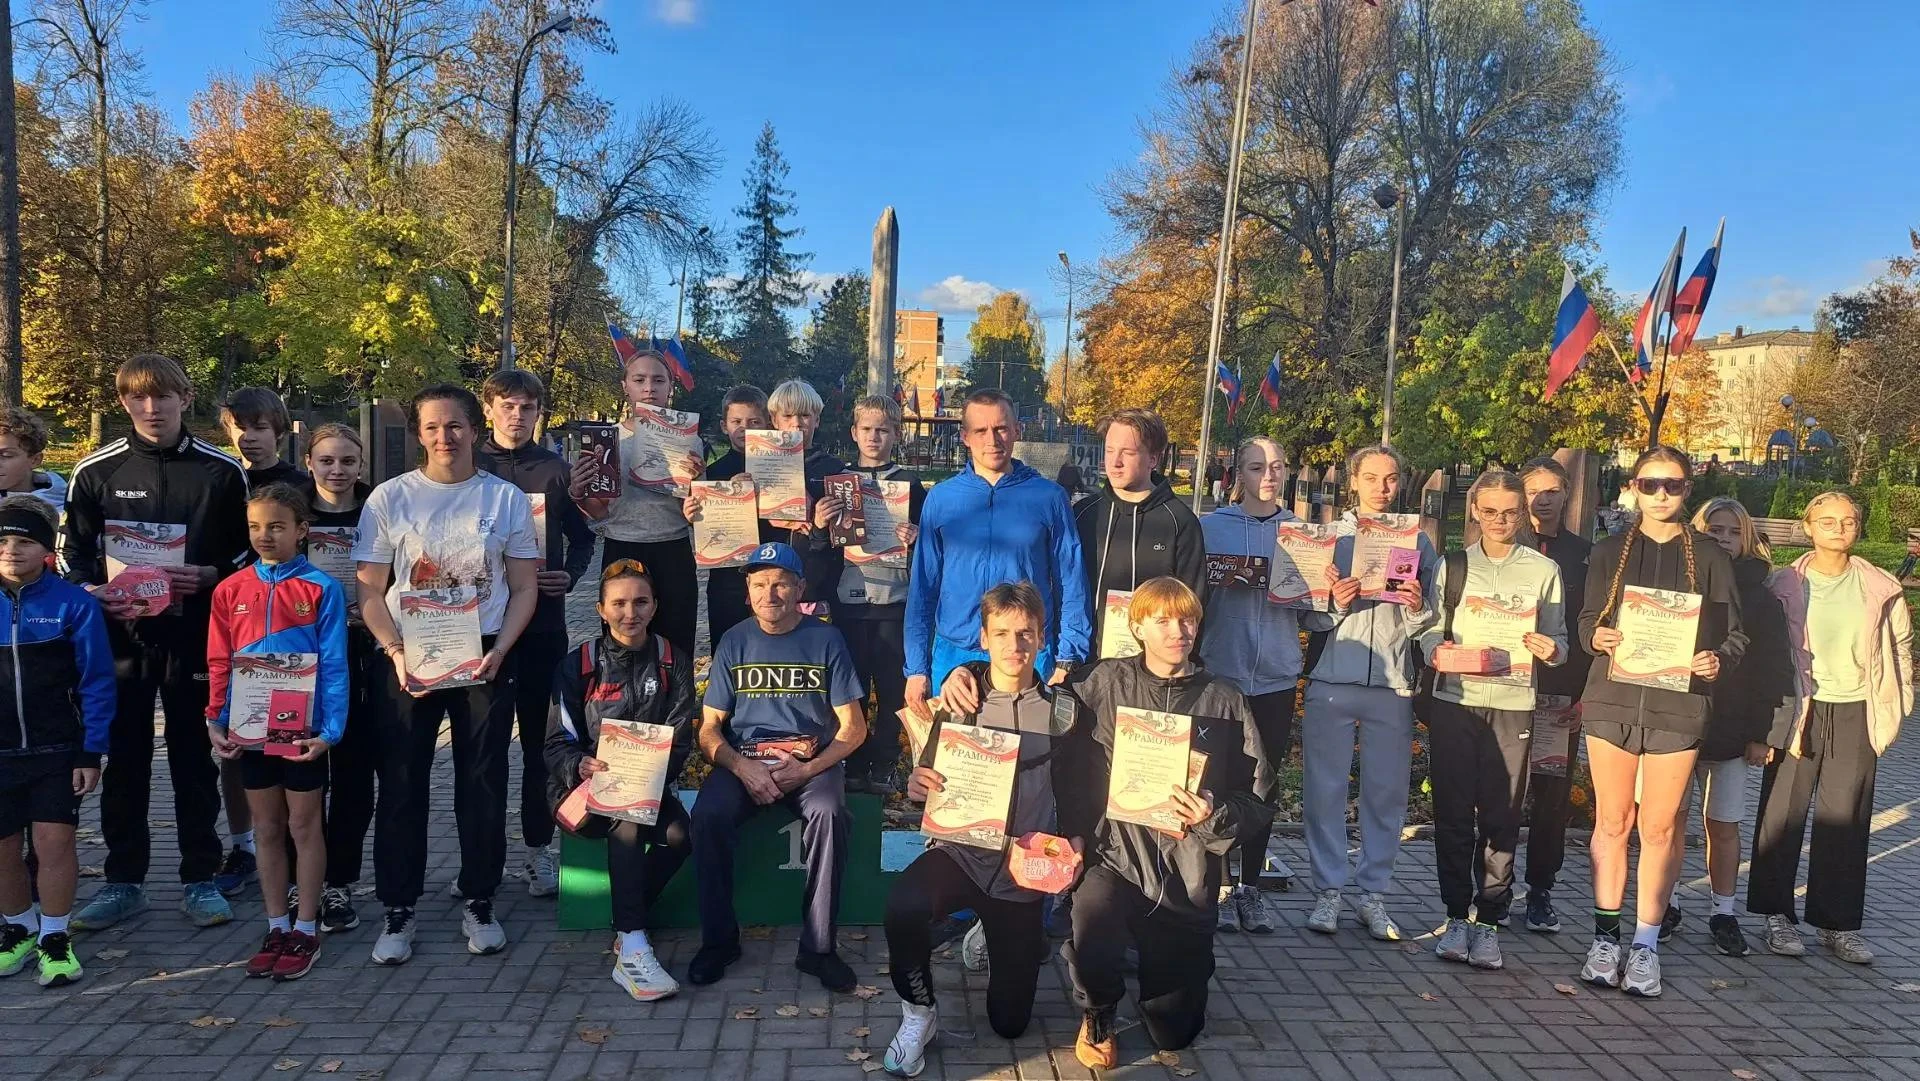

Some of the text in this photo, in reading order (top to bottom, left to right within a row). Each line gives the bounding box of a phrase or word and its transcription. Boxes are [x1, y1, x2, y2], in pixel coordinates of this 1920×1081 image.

[115, 490, 149, 498] SKINSK
[843, 480, 854, 511] Choco
[120, 541, 170, 552] ГРАМОТА
[1153, 542, 1166, 551] alo
[1209, 561, 1237, 571] Choco
[1209, 570, 1225, 580] Pie
[416, 608, 466, 619] ГРАМОТА
[1636, 607, 1684, 621] ГРАМОТА
[248, 670, 303, 680] ГРАМОТА
[737, 667, 821, 689] JONES
[1128, 731, 1175, 747] ГРАМОТА
[612, 740, 658, 753] ГРАМОТА
[951, 747, 1002, 765] ГРАМОТА
[777, 819, 807, 870] 1
